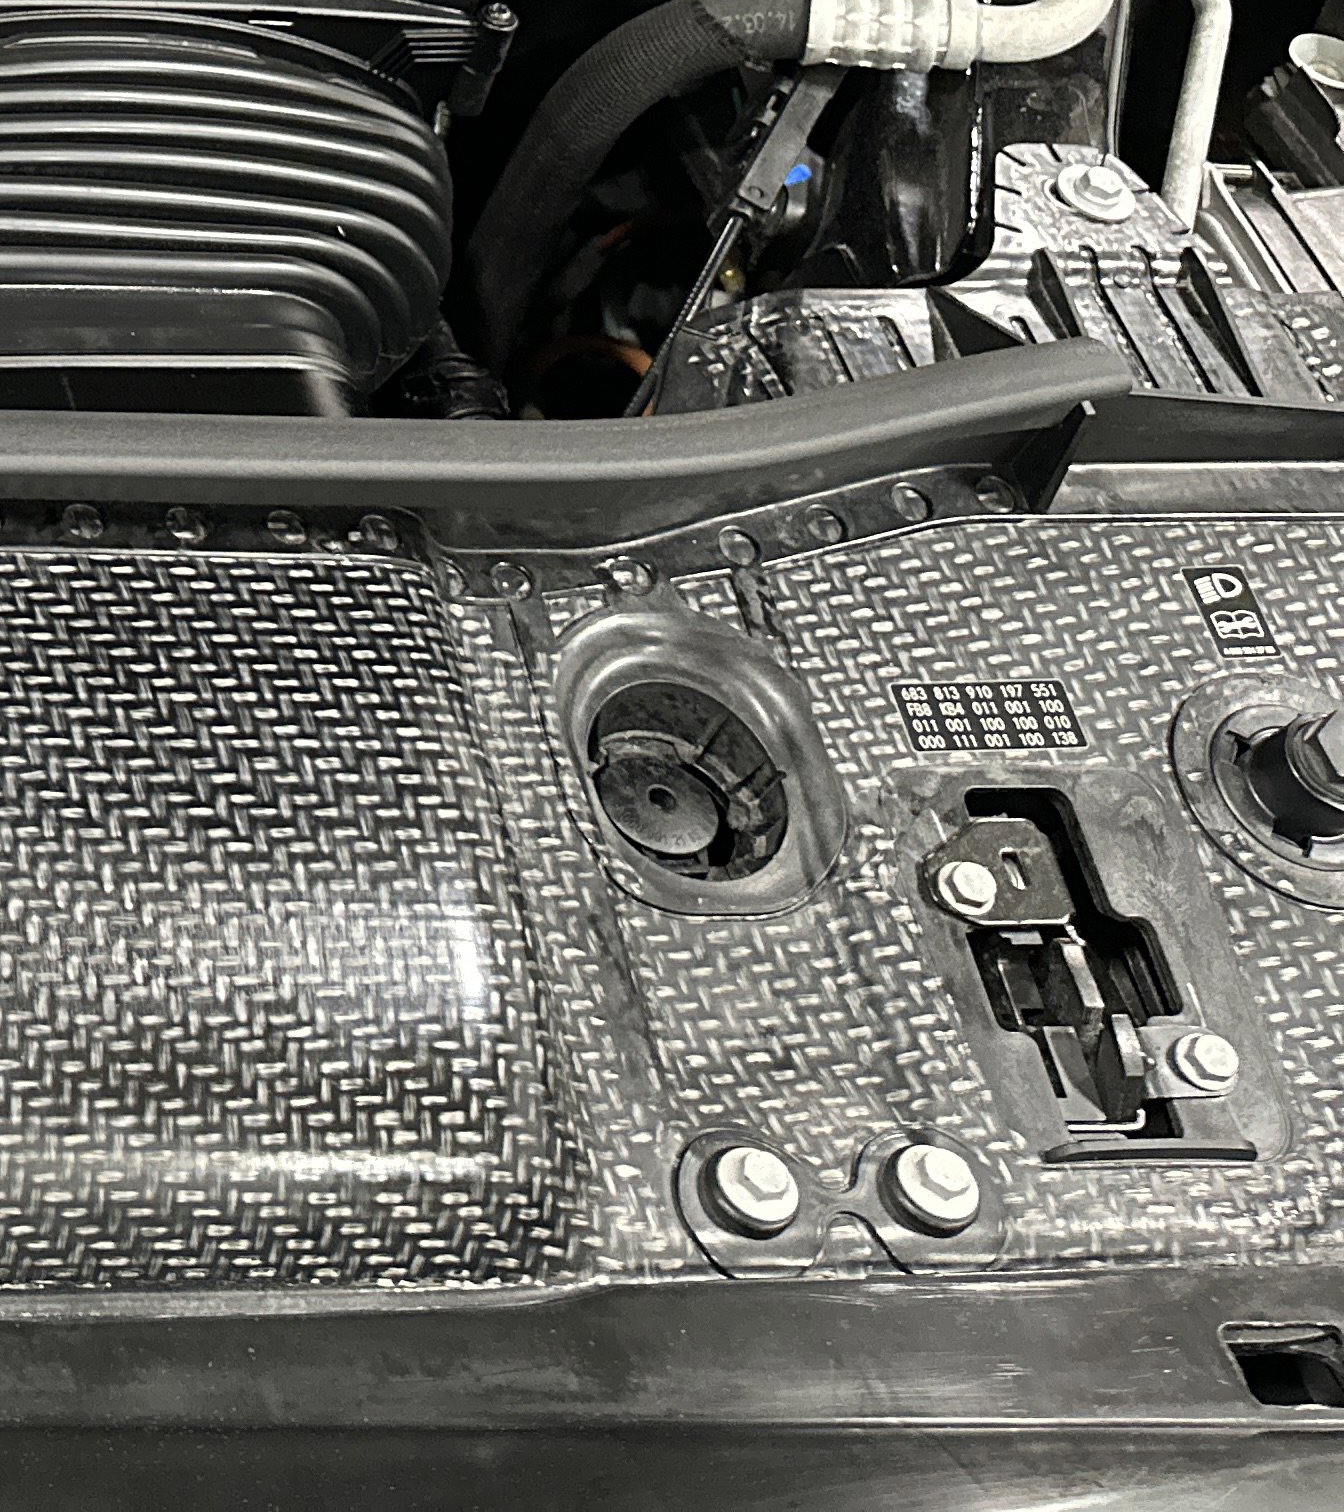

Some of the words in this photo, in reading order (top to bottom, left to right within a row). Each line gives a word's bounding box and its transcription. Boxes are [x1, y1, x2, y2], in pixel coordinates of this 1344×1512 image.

[933, 686, 960, 700] 813
[965, 685, 993, 700] 910
[1000, 684, 1023, 698] 197
[1031, 683, 1057, 698] 551
[906, 702, 933, 717] FB8
[972, 701, 998, 716] 011
[1004, 700, 1031, 714] 001
[1038, 699, 1064, 713] 100
[912, 719, 939, 733] 011
[945, 718, 972, 732] 001
[980, 717, 1006, 731] 100
[1012, 716, 1039, 730] 100
[1043, 715, 1072, 729] 010
[918, 735, 946, 749] 000
[953, 734, 978, 748] 111
[984, 733, 1011, 748] 001
[1019, 733, 1045, 747] 100
[1052, 731, 1079, 745] 138
